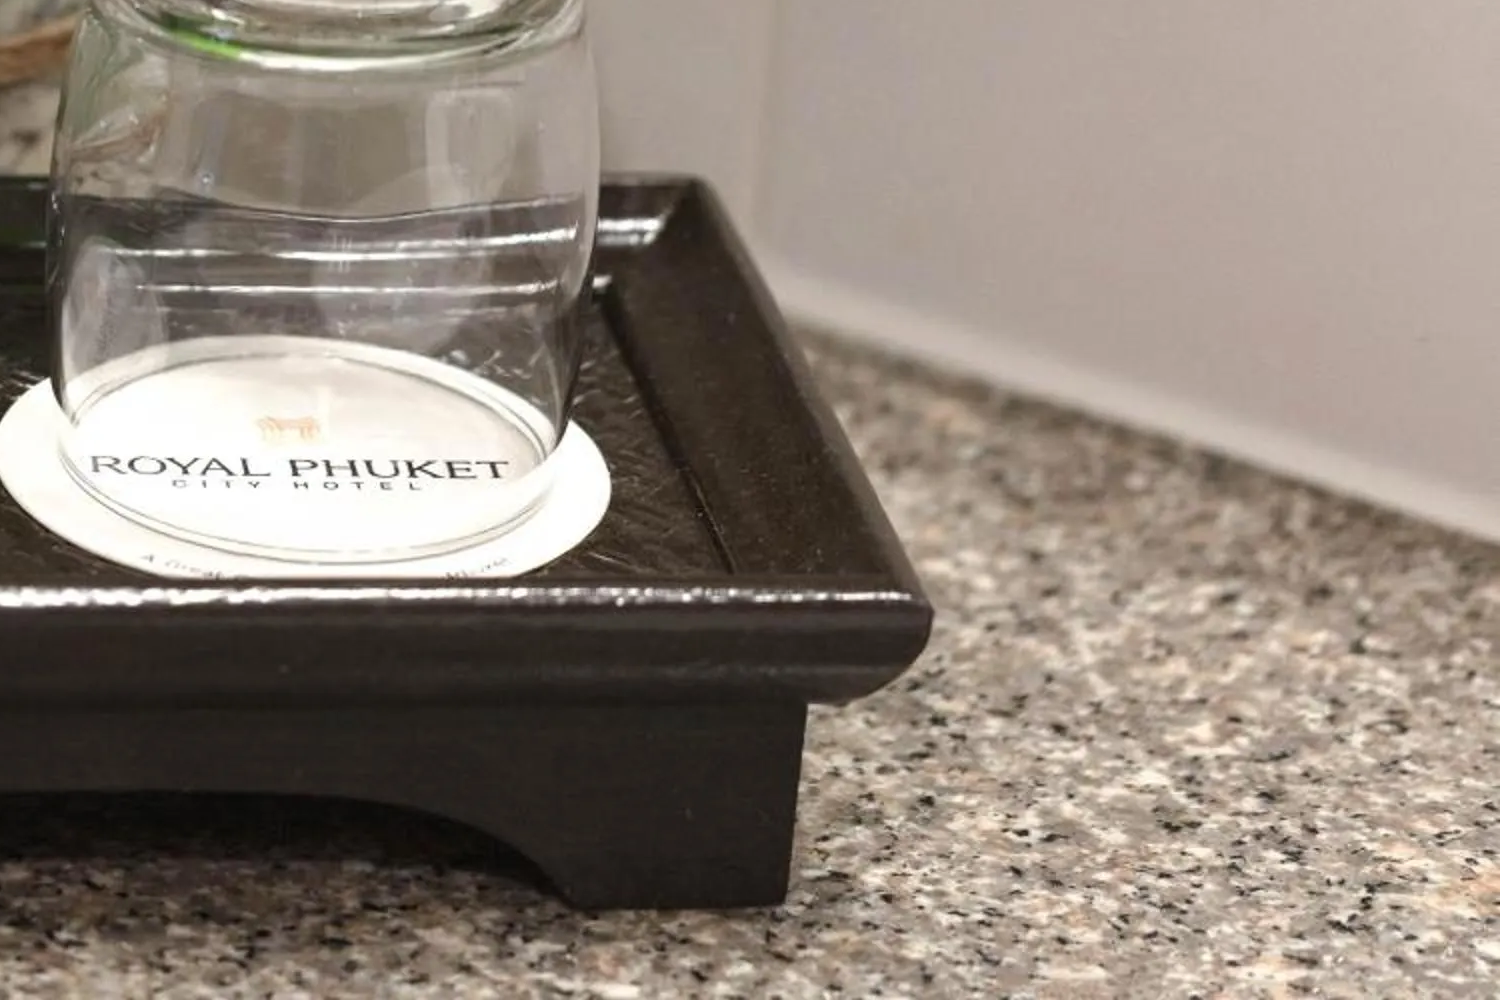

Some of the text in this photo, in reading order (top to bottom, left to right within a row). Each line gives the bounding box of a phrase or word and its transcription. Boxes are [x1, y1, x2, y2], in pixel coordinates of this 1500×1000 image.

[90, 455, 510, 480] ROYAL PHUKET
[172, 479, 420, 491] CITY HOTEL
